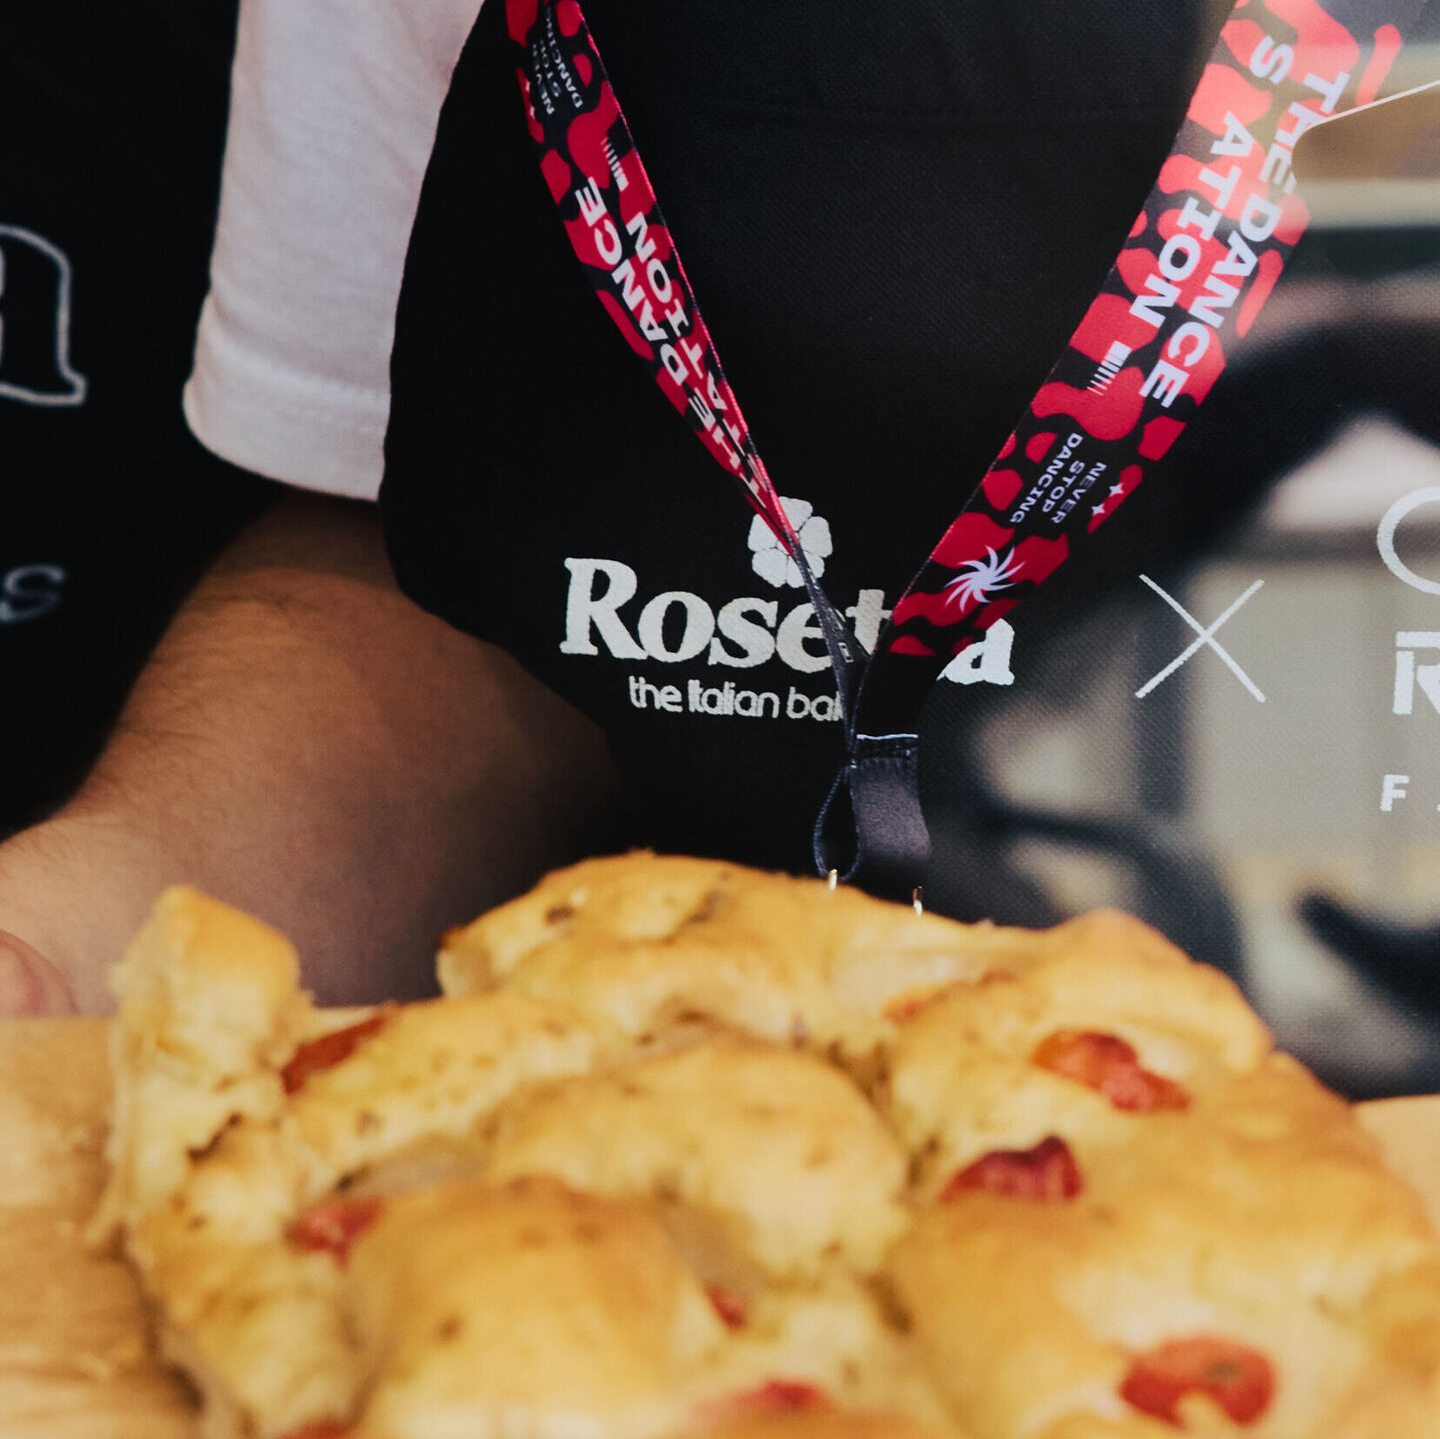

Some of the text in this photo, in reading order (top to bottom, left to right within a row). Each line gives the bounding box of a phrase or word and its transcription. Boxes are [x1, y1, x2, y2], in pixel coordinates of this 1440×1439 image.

[1129, 34, 1294, 329] SATION
[574, 176, 768, 509] THE DANCE
[1138, 193, 1283, 409] DANCE
[1009, 432, 1084, 524] DANCING
[1041, 460, 1086, 514] STOP
[1051, 462, 1108, 524] NEVER
[559, 557, 1016, 687] Roseta
[628, 675, 684, 713] the
[687, 678, 781, 719] Italian
